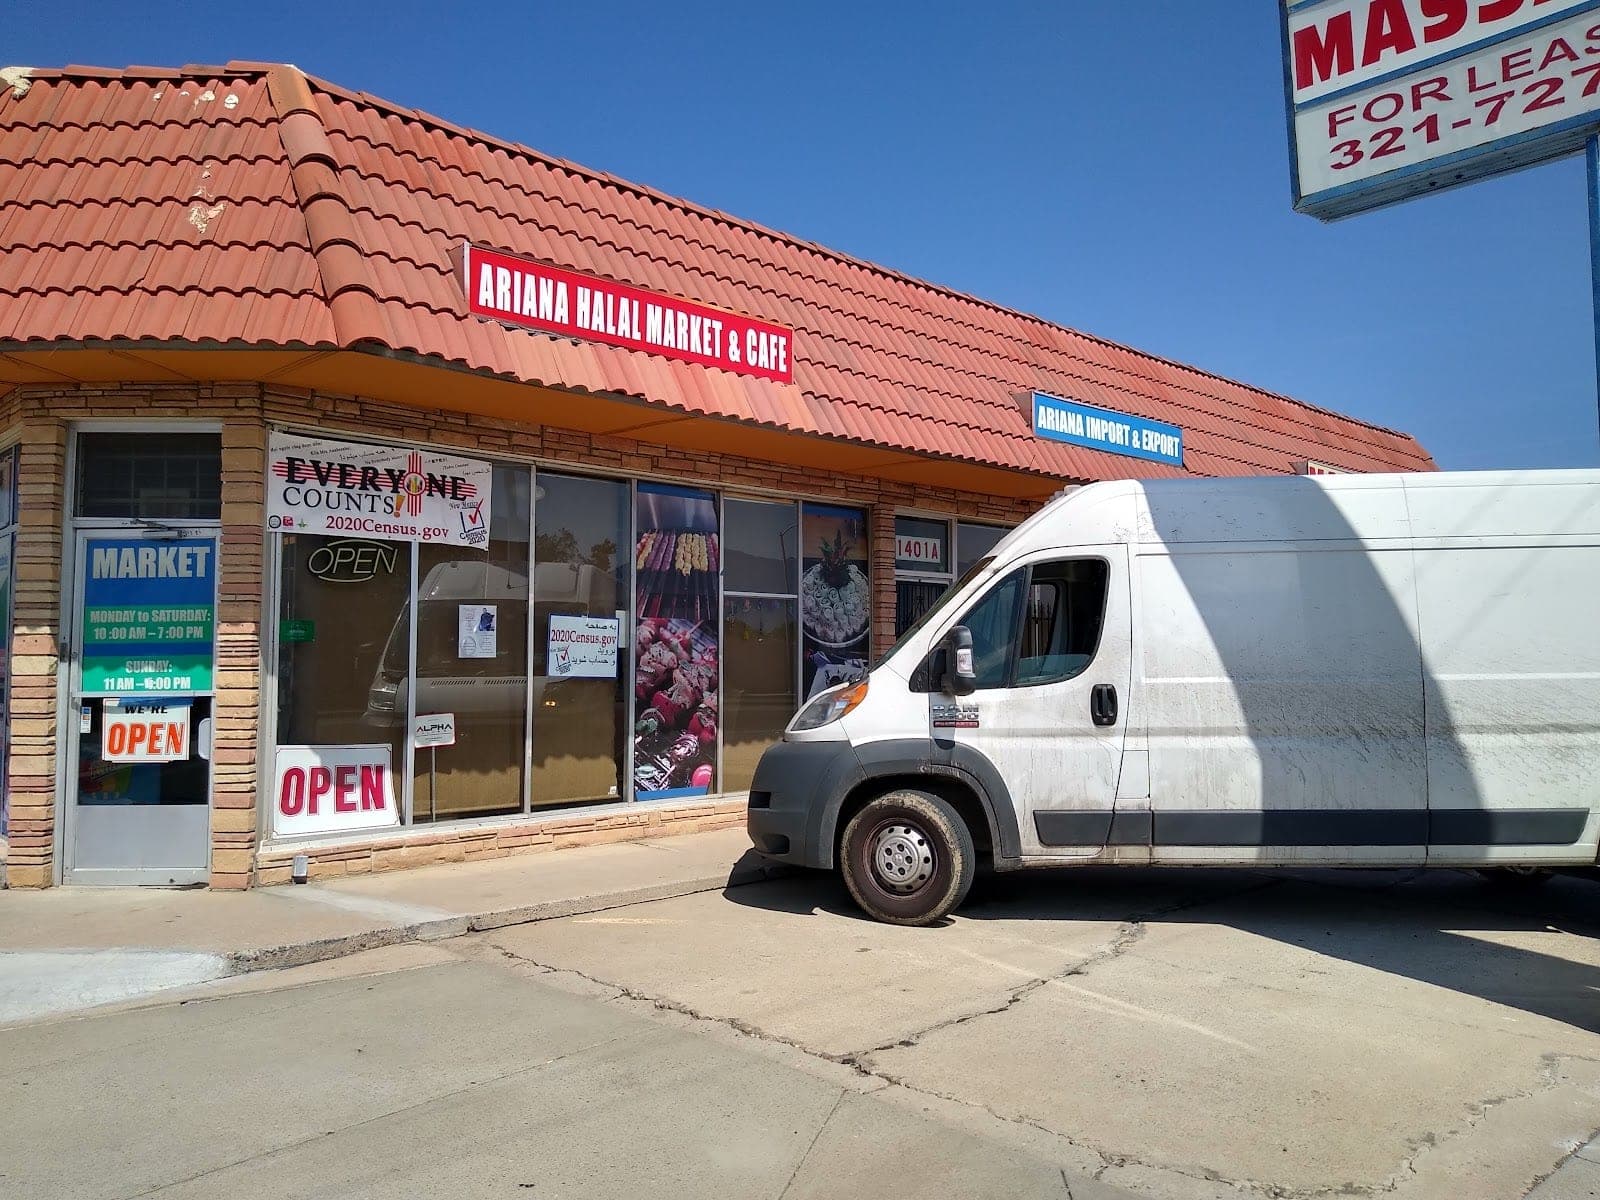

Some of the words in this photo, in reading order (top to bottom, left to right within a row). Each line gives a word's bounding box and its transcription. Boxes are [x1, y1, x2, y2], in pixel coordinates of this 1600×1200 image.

[1293, 0, 1552, 90] MAS
[1328, 76, 1452, 138] FOR
[1330, 62, 1600, 170] 321-727
[478, 263, 569, 324] ARIANA
[576, 286, 641, 340] HALAL
[646, 303, 723, 358] MARKET
[728, 329, 741, 363] &
[746, 328, 787, 372] CAFE
[1037, 405, 1084, 436] ARIANA
[1086, 415, 1130, 446] IMPORT
[1132, 429, 1141, 449] &
[1142, 428, 1180, 458] EXPORT
[326, 515, 449, 540] 2020Census.gov
[92, 546, 211, 579] MARKET
[308, 547, 398, 574] OPEN
[897, 539, 939, 560] 1401A
[90, 610, 136, 623] MONDAY
[138, 611, 150, 622] to
[151, 609, 211, 622] SATURDAY:
[128, 627, 146, 640] AM
[186, 626, 203, 639] PM
[551, 629, 616, 648] 2020Census.gov
[125, 660, 173, 674] SUNDAY:
[103, 678, 115, 690] 11
[116, 677, 134, 690] AM
[173, 676, 191, 690] PM
[124, 704, 168, 714] WE'RE
[107, 722, 185, 756] OPEN
[416, 723, 453, 732] ALPHA
[278, 763, 388, 817] OPEN
